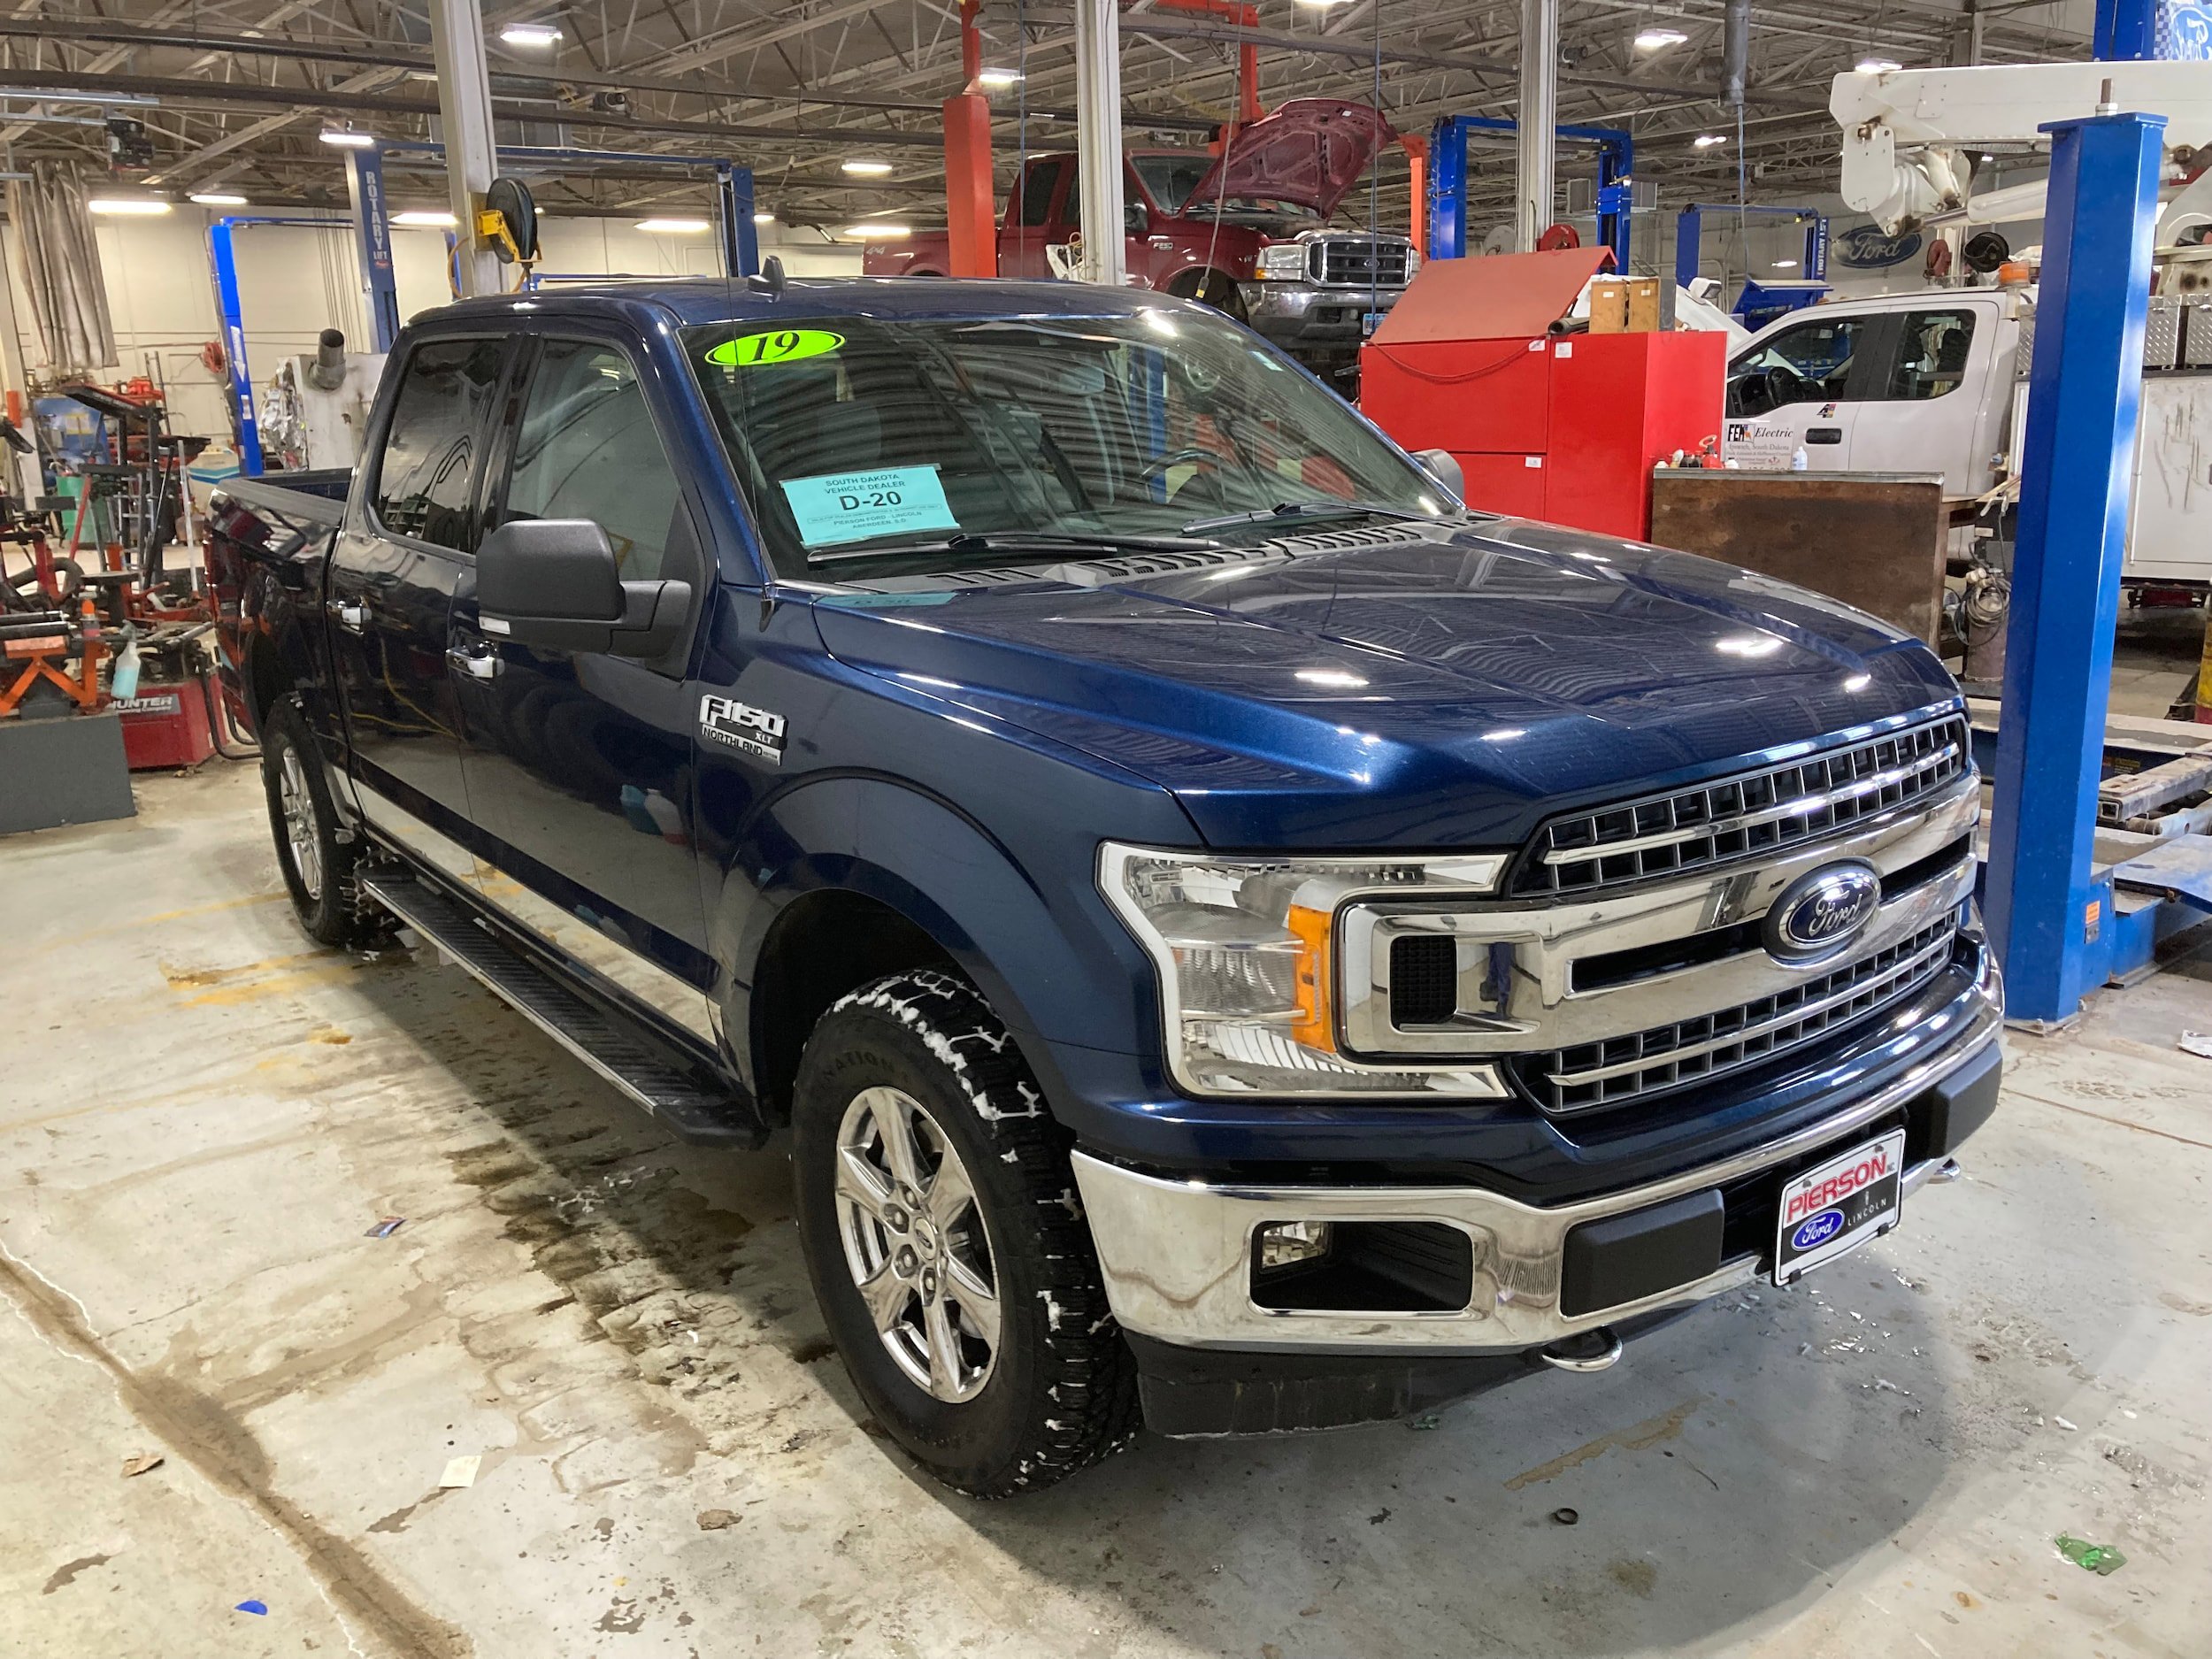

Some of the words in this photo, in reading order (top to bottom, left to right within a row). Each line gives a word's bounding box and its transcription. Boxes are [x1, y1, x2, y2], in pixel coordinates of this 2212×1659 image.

[365, 171, 382, 250] ROTARY
[1848, 231, 1901, 261] Ford
[747, 332, 800, 362] 19
[1755, 426, 1793, 438] Electric
[825, 484, 866, 494] VEHICLE
[867, 480, 906, 490] DEALER
[826, 476, 858, 487] SOUTH
[860, 473, 900, 483] DAKOTA
[839, 491, 902, 511] D-20
[703, 726, 763, 756] NORTHLAND
[755, 732, 773, 744] XLT
[1809, 887, 1863, 937] Ford
[1786, 1152, 1888, 1224] PIERSON
[1801, 1216, 1834, 1244] Ford
[1847, 1197, 1887, 1226] LINCOLN
